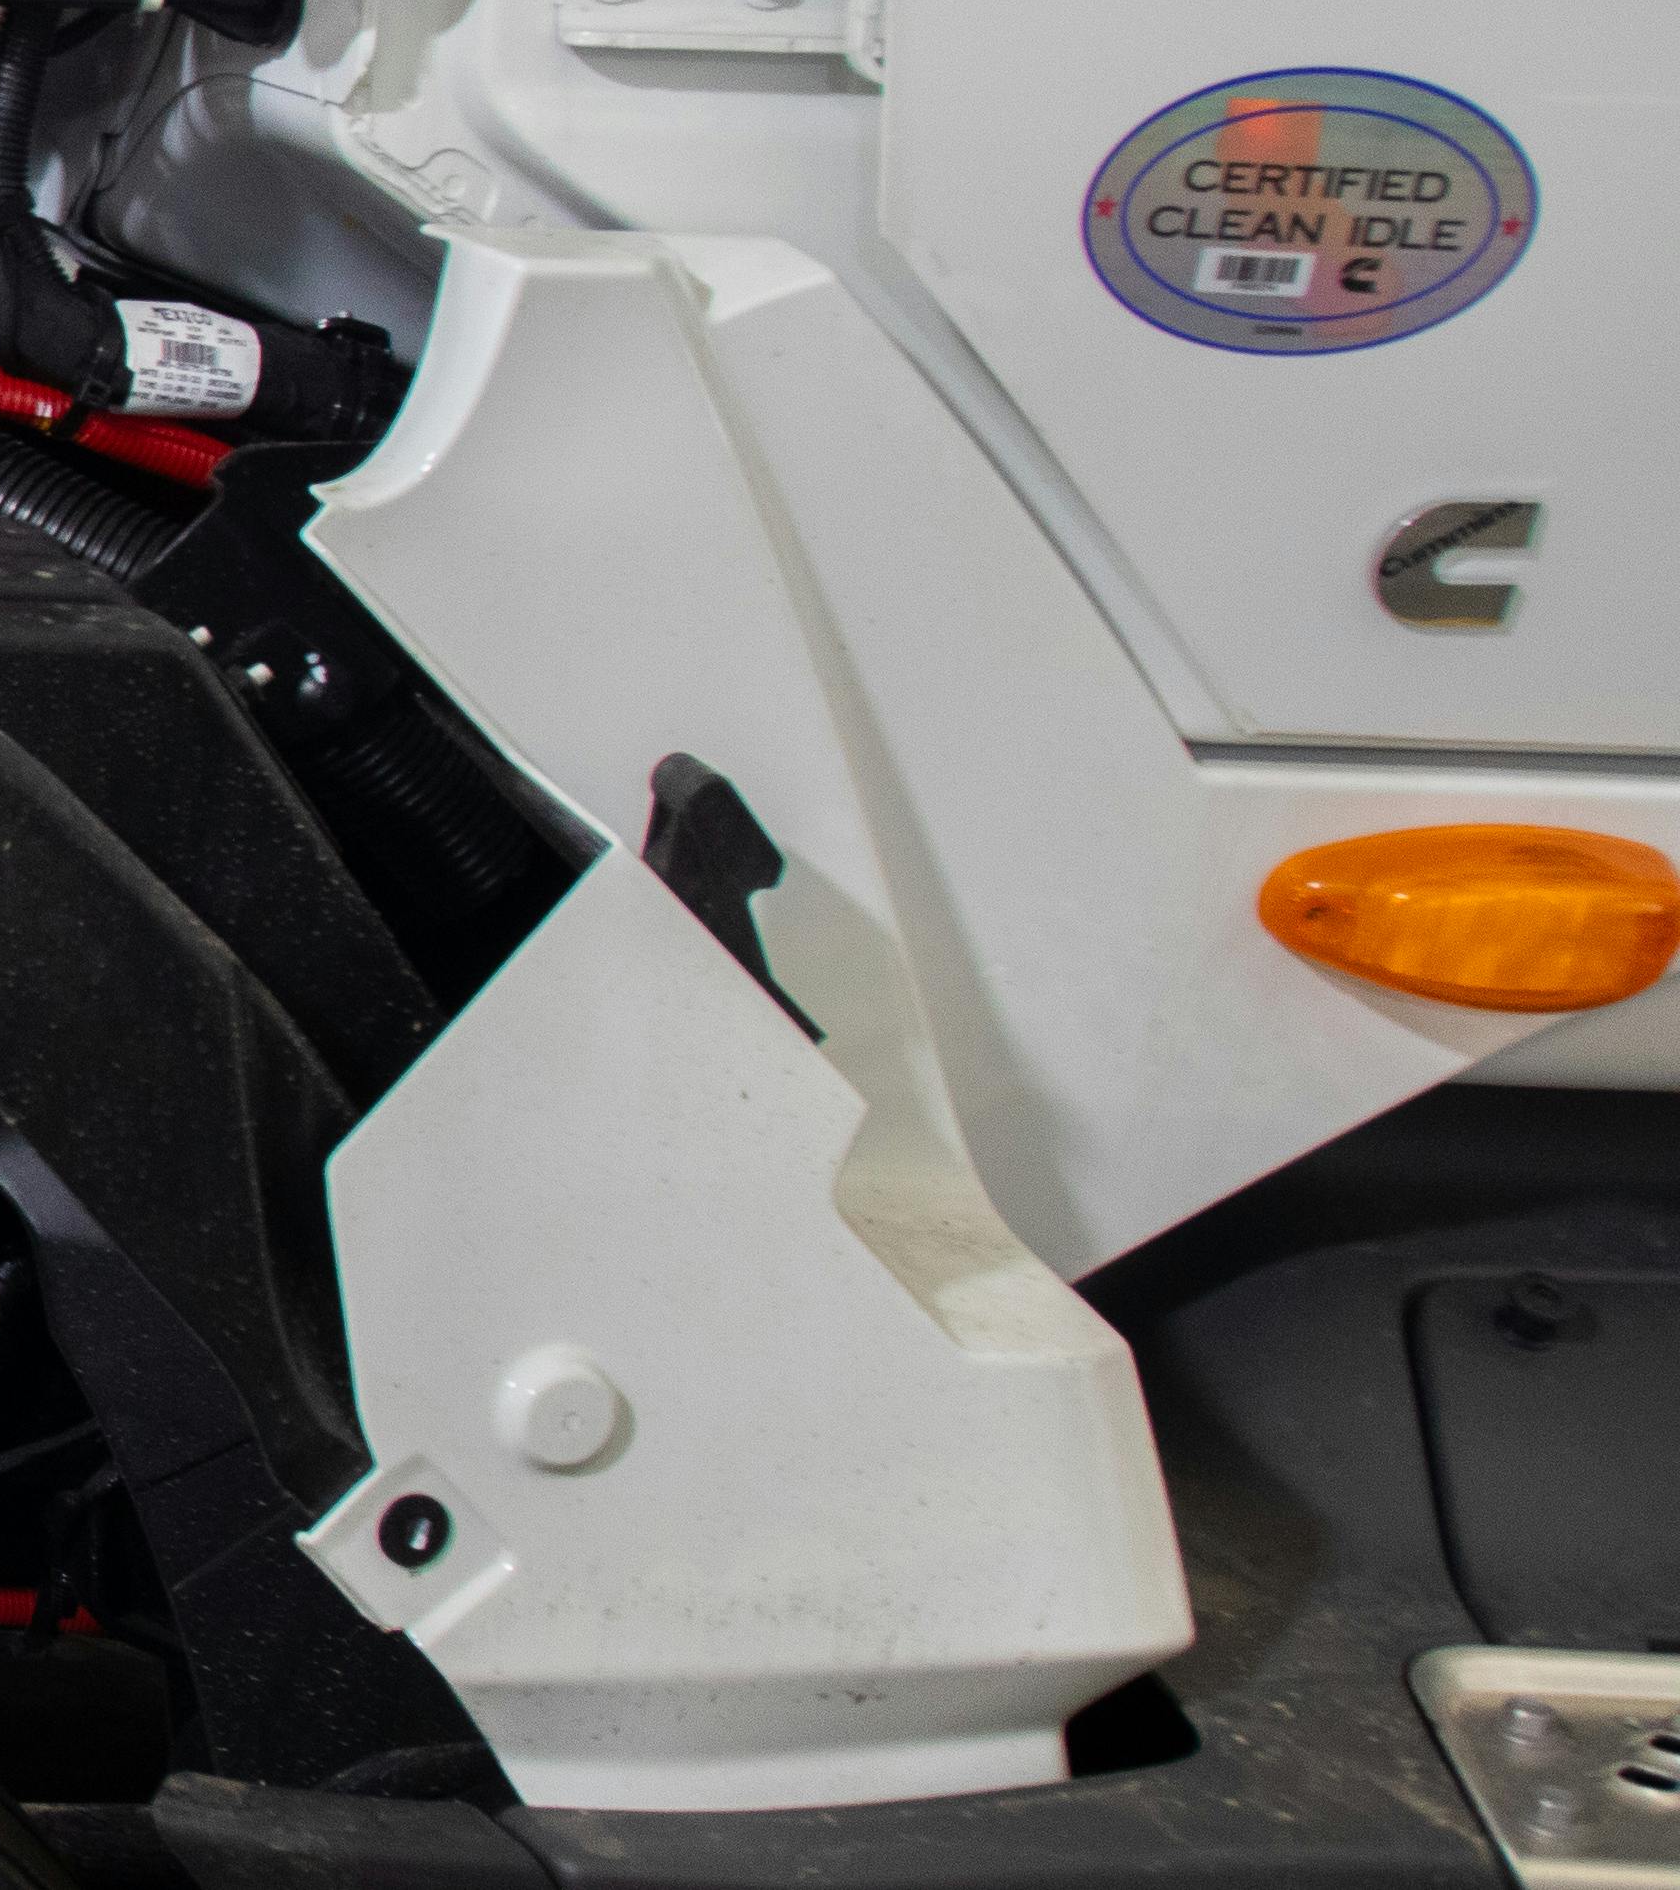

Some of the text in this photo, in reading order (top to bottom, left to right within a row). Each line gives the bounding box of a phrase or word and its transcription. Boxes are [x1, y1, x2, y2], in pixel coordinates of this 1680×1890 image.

[1184, 159, 1450, 203] CERTIFIED
[1148, 206, 1467, 252] CLEAN IDLE
